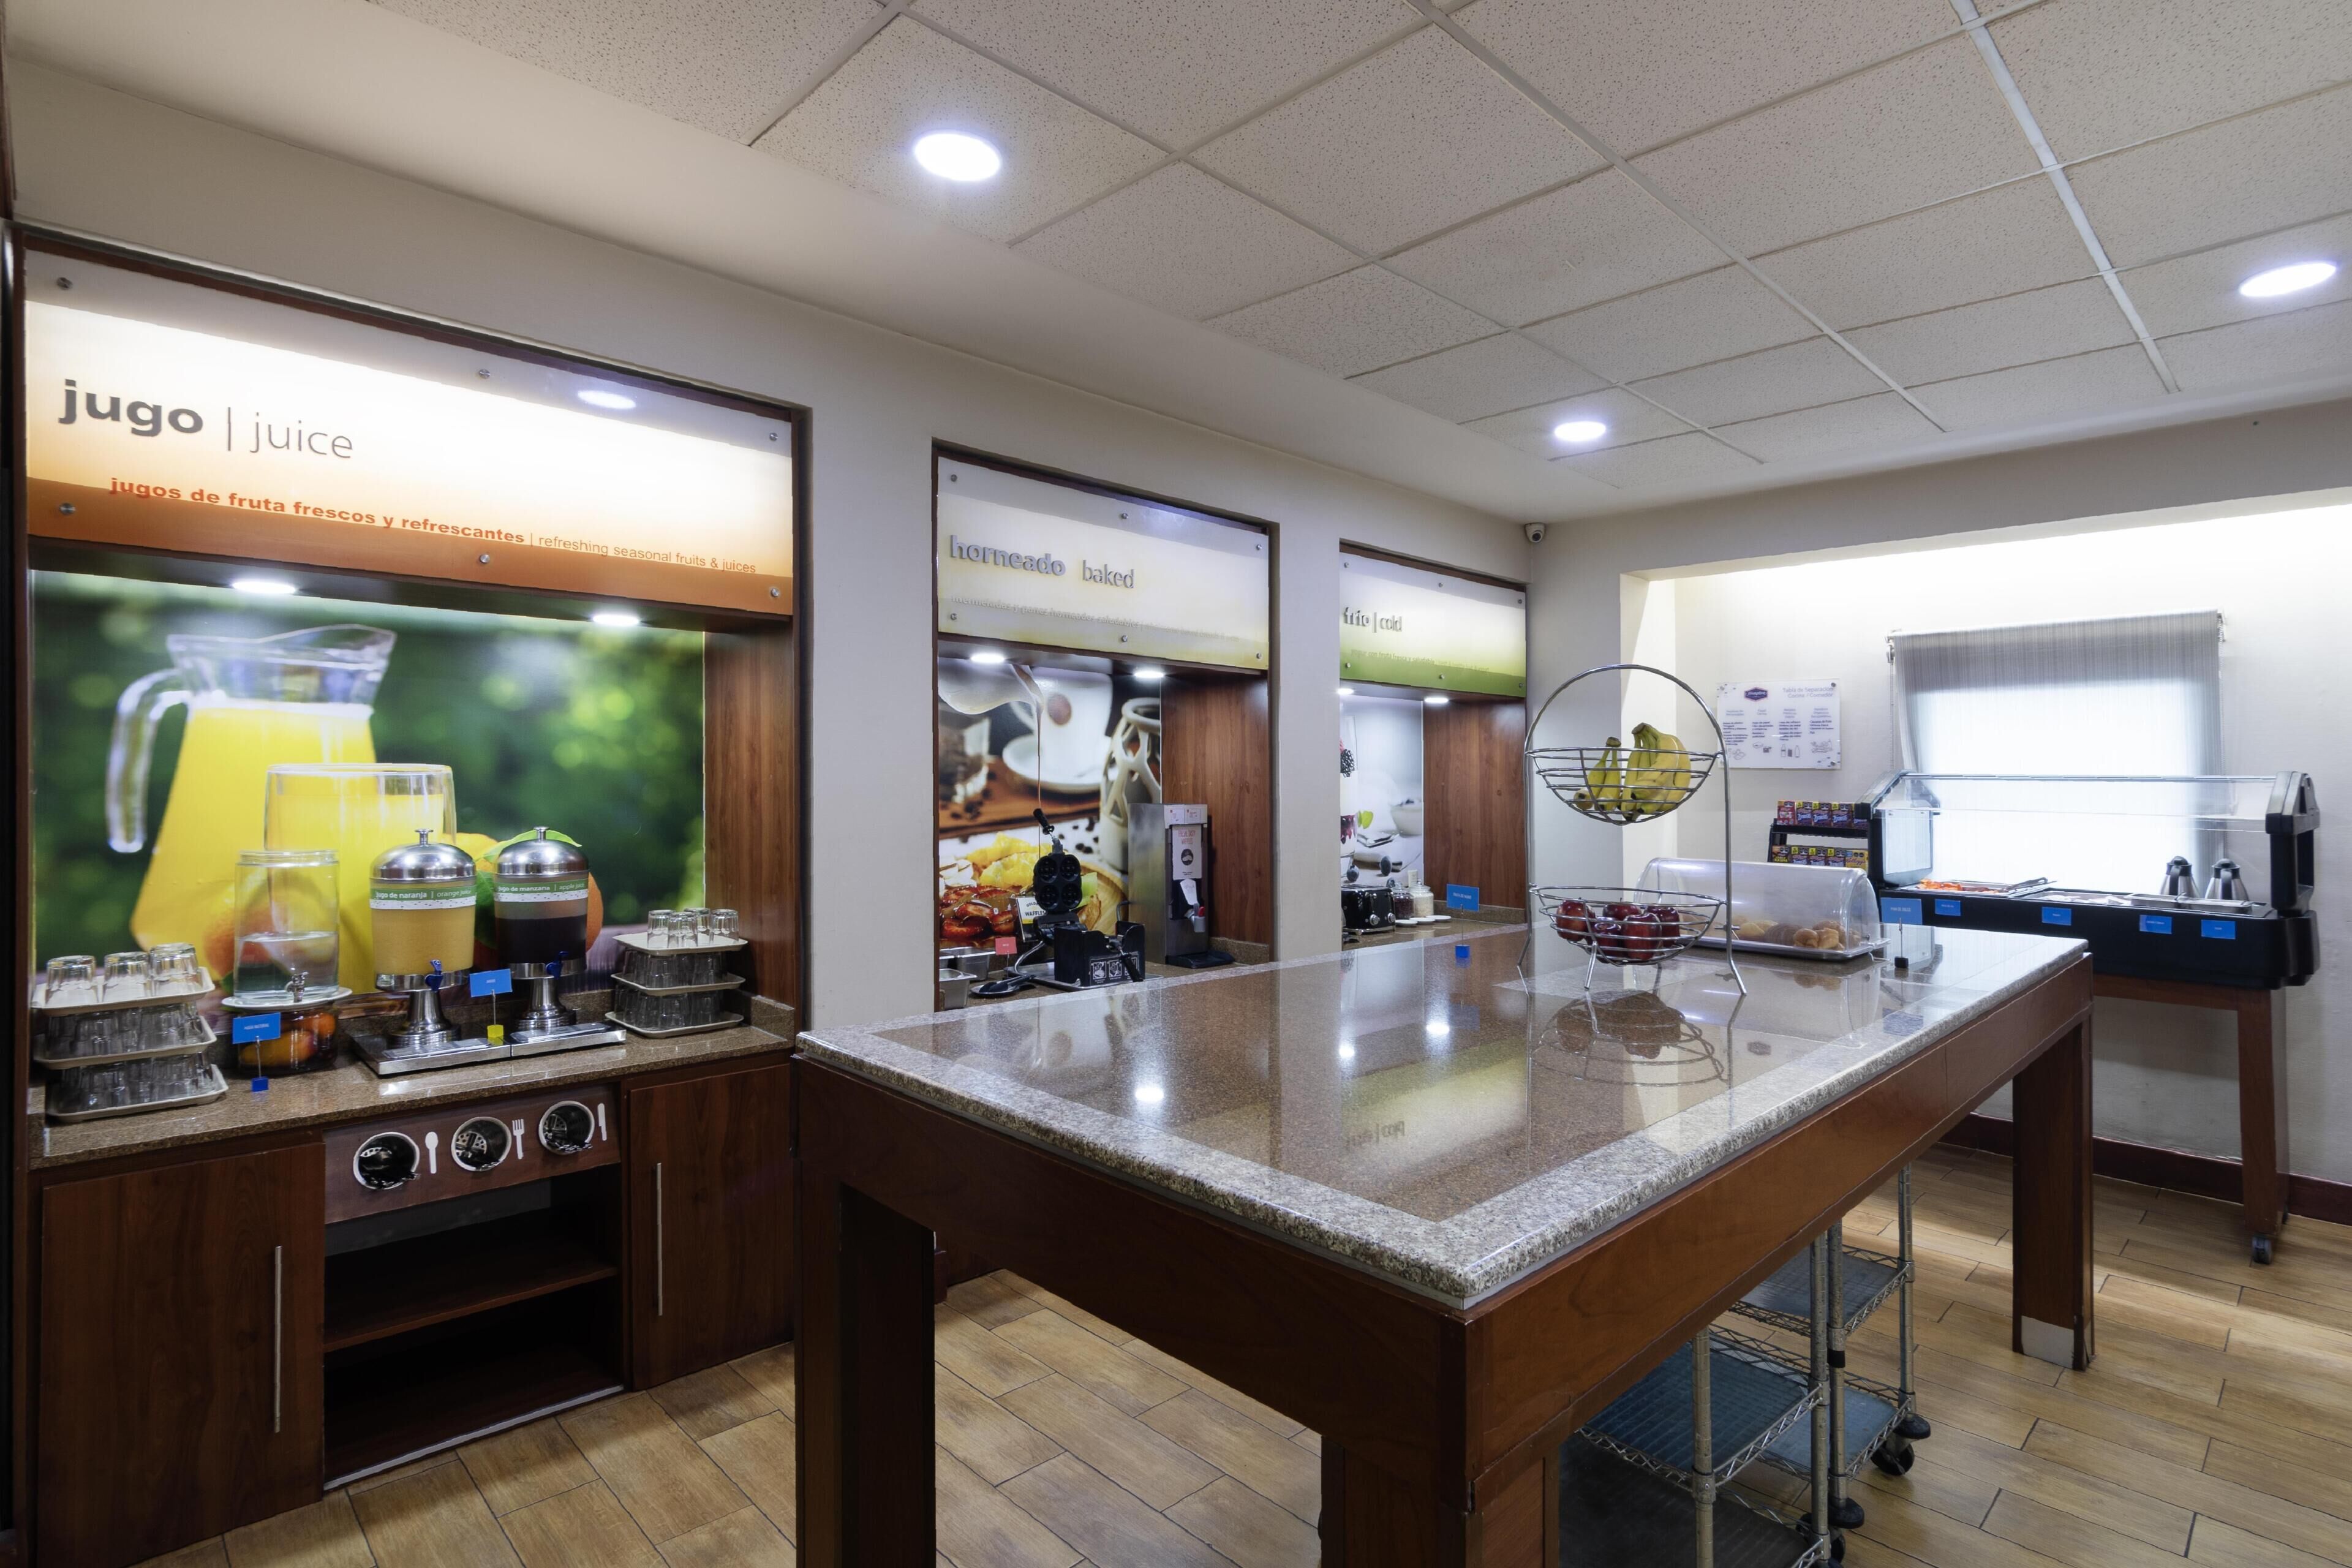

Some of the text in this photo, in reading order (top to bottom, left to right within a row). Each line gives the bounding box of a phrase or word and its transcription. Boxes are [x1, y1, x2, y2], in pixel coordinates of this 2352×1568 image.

[58, 379, 353, 459] jugo juice
[109, 477, 756, 573] jugos de fruta frescos y refrescantes refreshing seasonal fruits & juices
[949, 534, 1134, 589] horneado baked
[1379, 615, 1402, 631] cold
